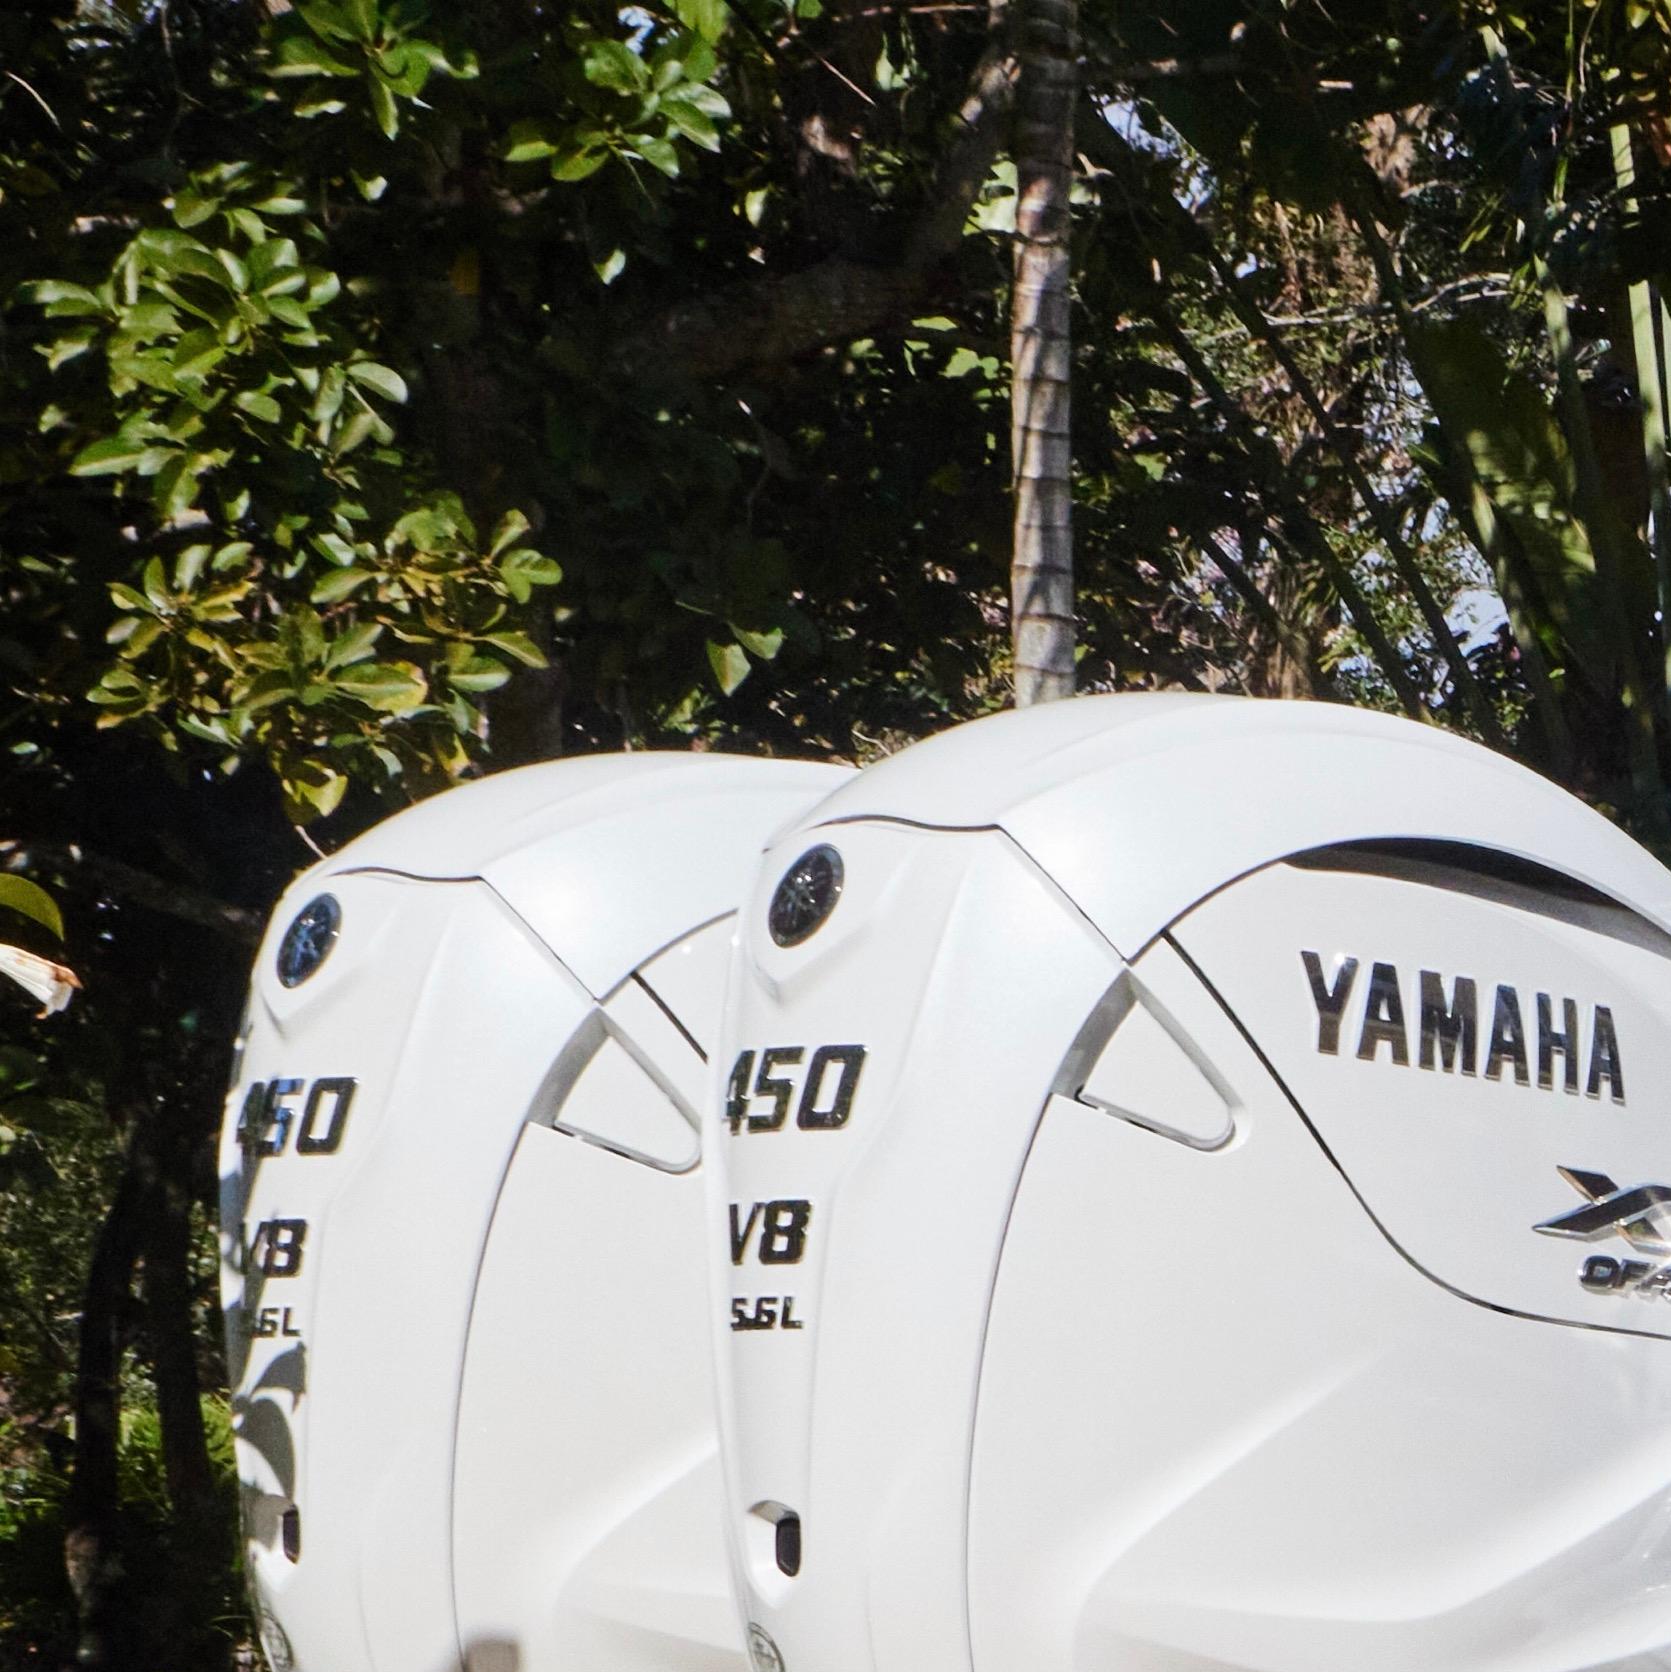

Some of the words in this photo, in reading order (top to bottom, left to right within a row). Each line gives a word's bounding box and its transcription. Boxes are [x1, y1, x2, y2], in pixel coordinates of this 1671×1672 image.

[1300, 949, 1627, 1106] YAMAHA
[725, 1044, 868, 1135] 450
[729, 1199, 813, 1266] V8
